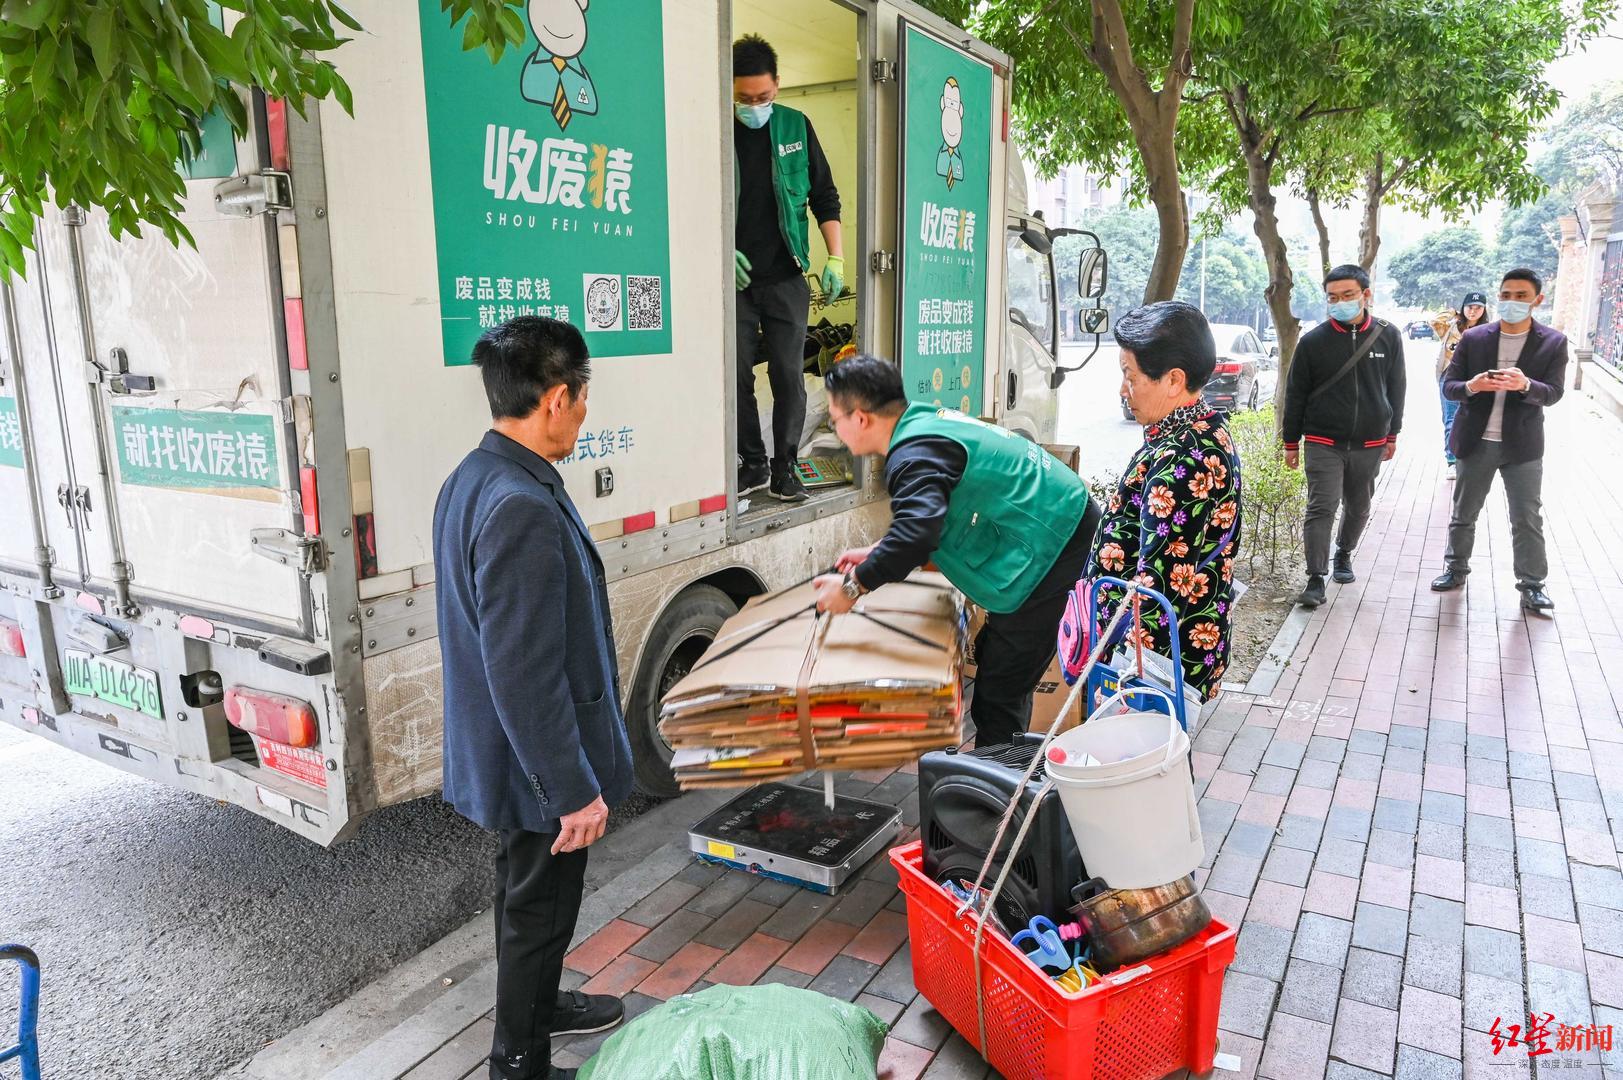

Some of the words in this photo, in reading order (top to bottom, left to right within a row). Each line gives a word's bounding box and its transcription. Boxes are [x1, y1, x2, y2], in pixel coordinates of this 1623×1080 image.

[483, 123, 633, 215] 收废猿
[485, 211, 536, 228] SHOU
[552, 218, 577, 232] FEI
[593, 222, 633, 237] YUAN
[920, 201, 976, 253] 收废猿
[455, 275, 552, 301] 废品变成钱
[918, 298, 974, 325] 废品变成钱
[917, 329, 973, 356] 就找收废猿
[122, 422, 270, 480] 就找收废猿
